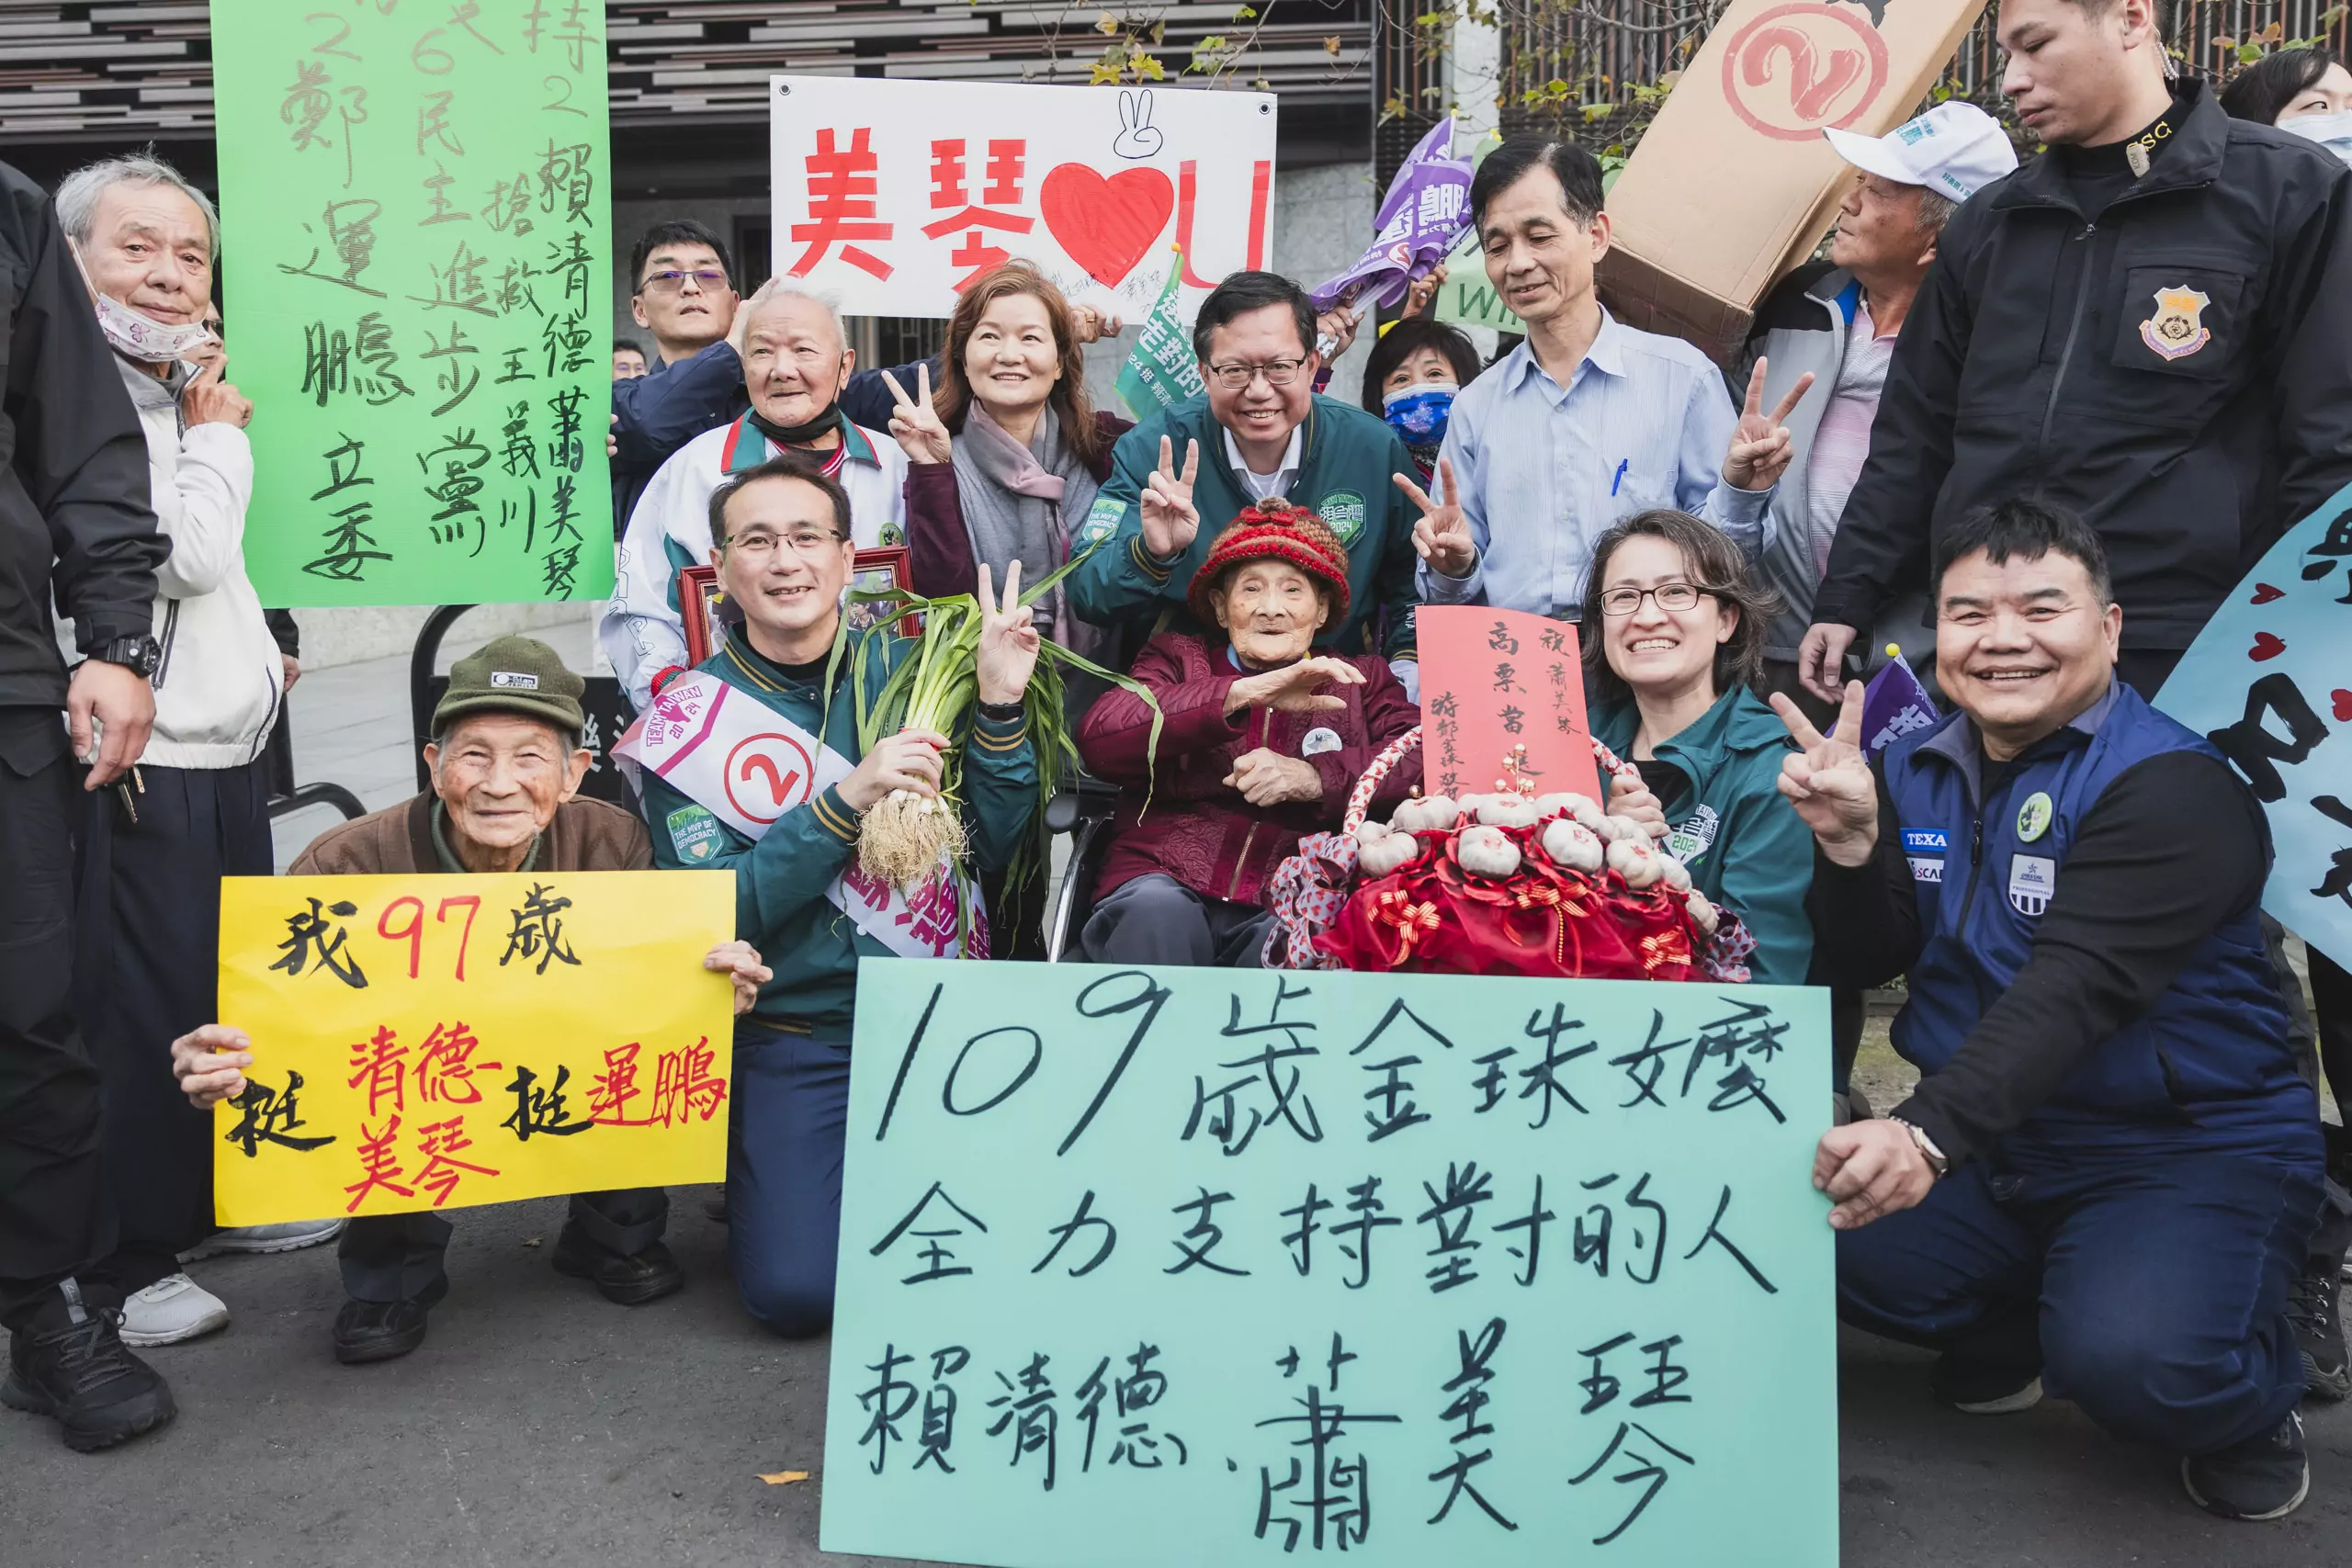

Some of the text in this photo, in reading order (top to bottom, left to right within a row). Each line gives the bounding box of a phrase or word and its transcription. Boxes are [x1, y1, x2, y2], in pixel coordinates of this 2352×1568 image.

[1742, 26, 1867, 121] 2
[2127, 120, 2172, 152] SC
[786, 128, 1271, 294] 美琴 U
[647, 685, 702, 747] TEAM TAIWAN
[741, 753, 800, 807] 2
[674, 820, 712, 840] THE MVP OF
[677, 829, 717, 849] DEMOCRACY
[1907, 833, 1947, 847] TEXA
[267, 882, 582, 988] 我97歲
[225, 1070, 337, 1157] 挺
[500, 1035, 728, 1141] 挺 運鵬
[344, 1114, 501, 1213] 美琴
[870, 1160, 1780, 1294] 全力支持對的人
